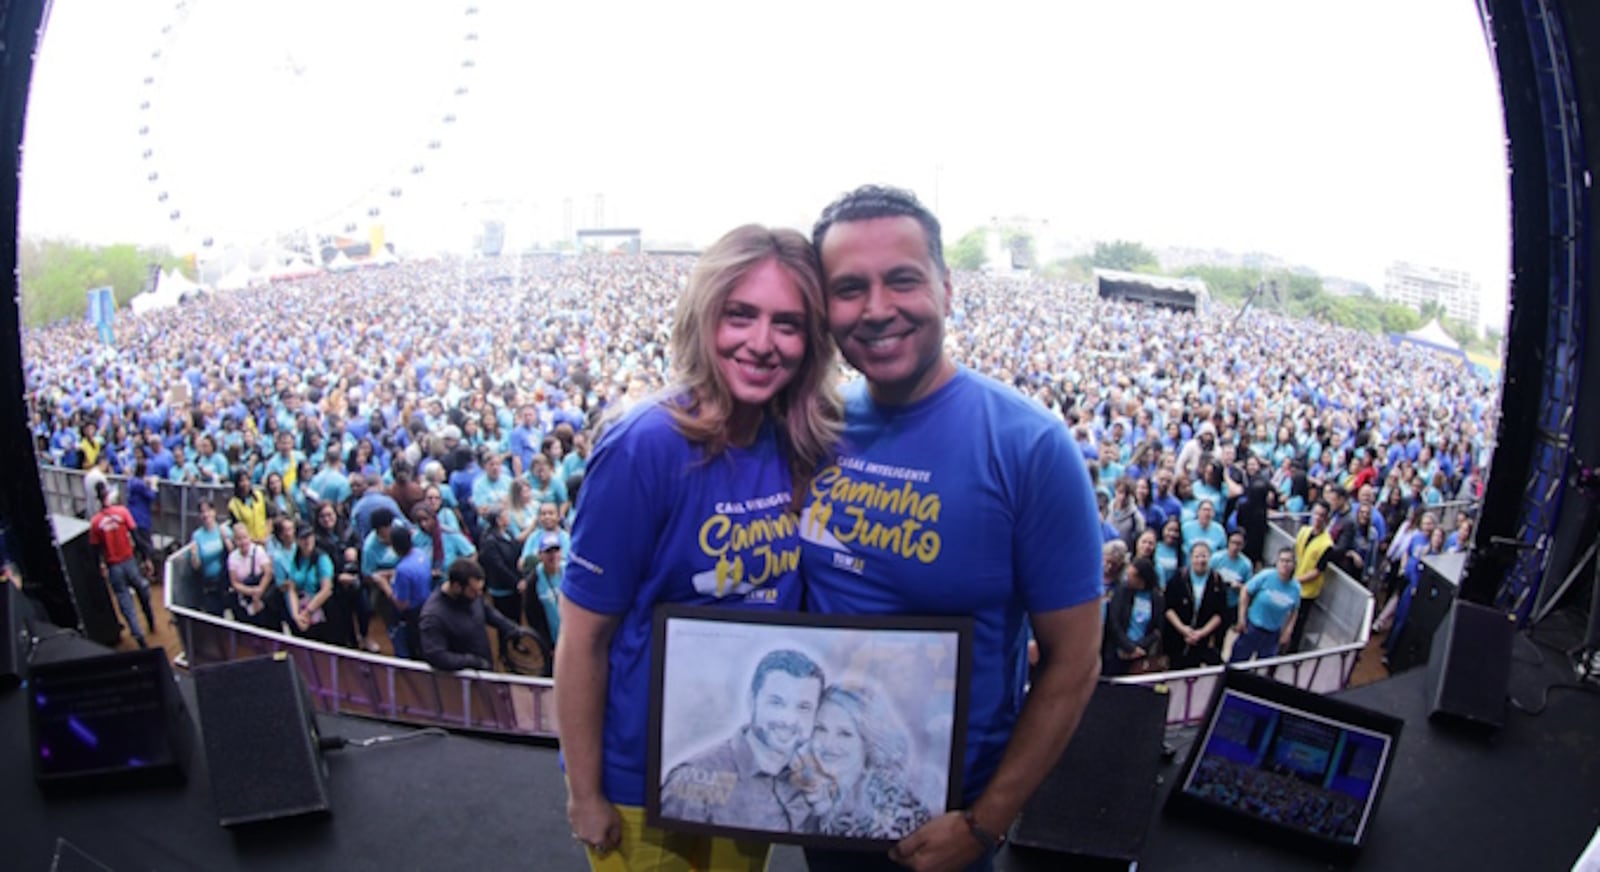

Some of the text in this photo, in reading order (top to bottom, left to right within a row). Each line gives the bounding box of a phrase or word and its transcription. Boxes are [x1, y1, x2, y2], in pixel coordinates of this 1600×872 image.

[810, 465, 941, 523] Caminha
[699, 513, 800, 557] Camin
[833, 505, 941, 564] Junto
[748, 544, 801, 585] Jun
